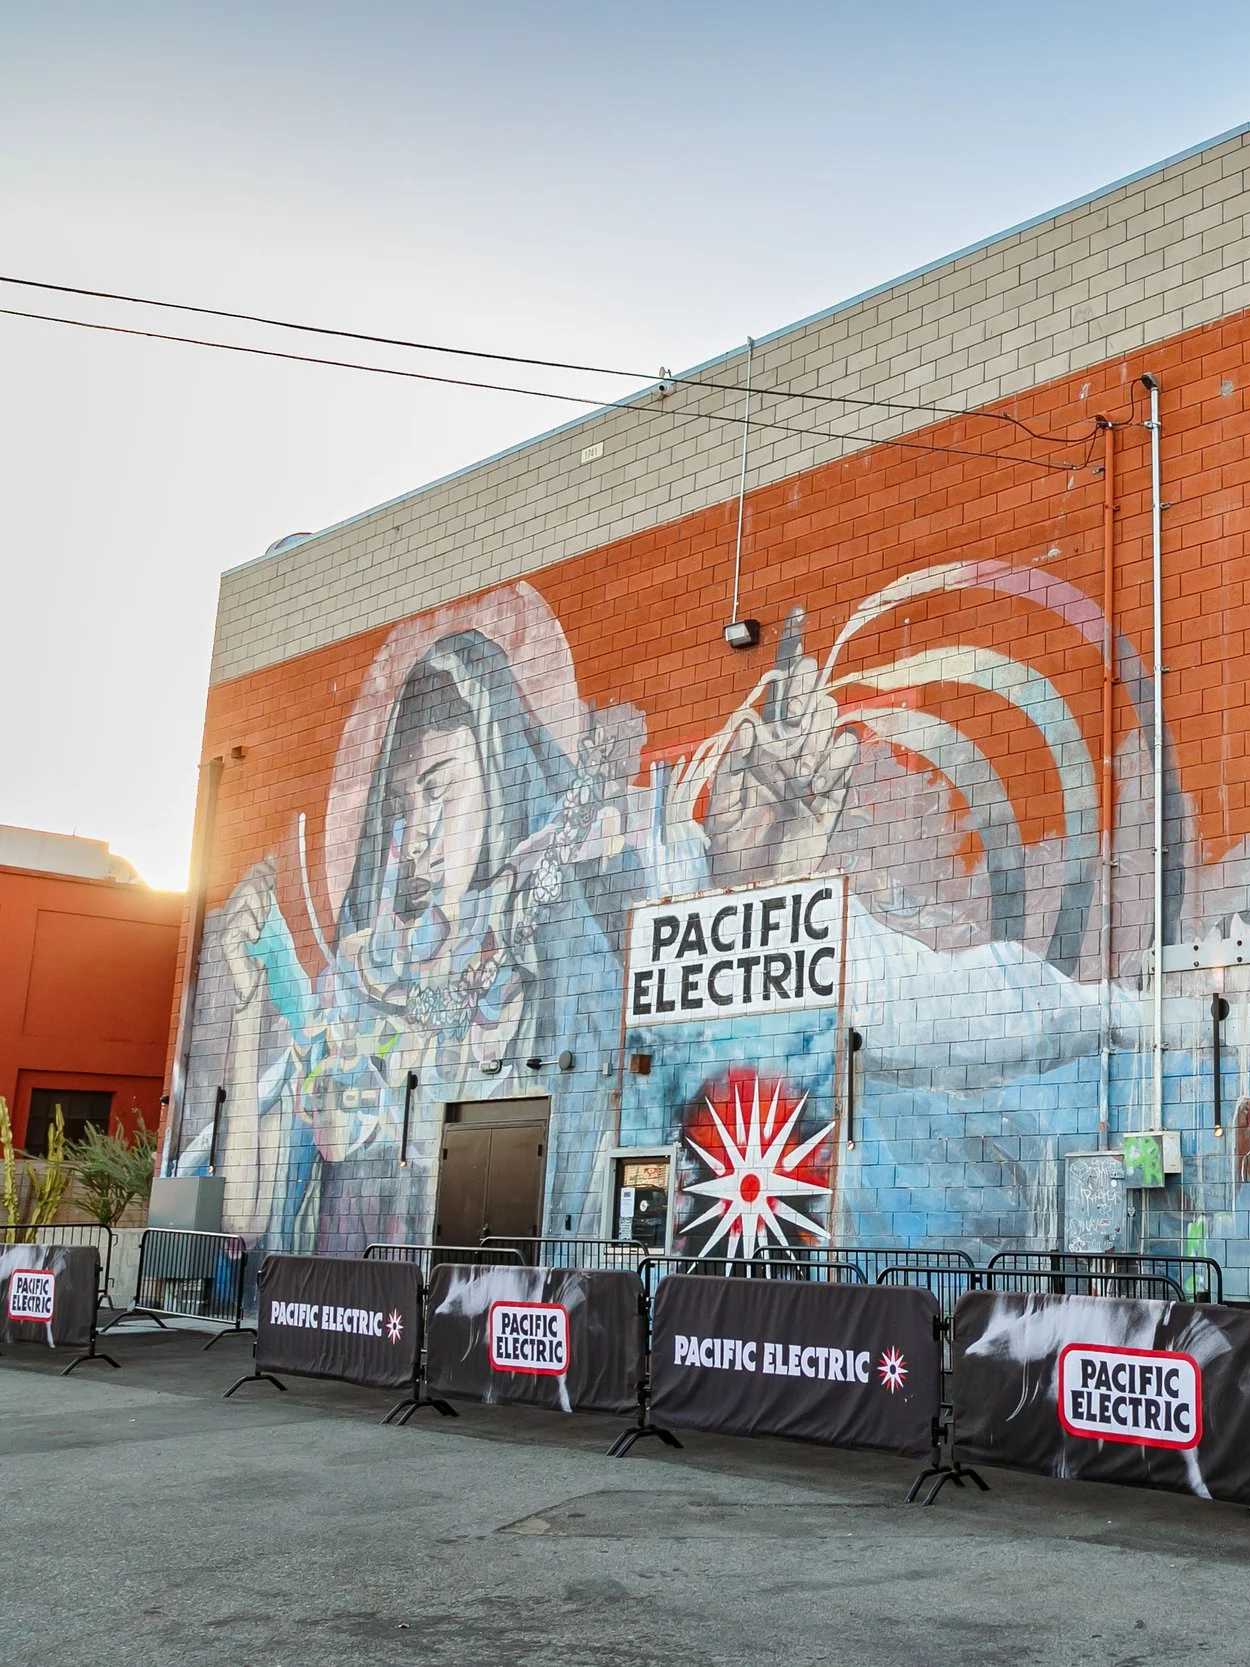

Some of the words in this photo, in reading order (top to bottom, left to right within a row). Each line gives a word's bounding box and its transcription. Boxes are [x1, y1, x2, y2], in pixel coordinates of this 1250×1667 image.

[652, 888, 832, 962] PACIFIC
[633, 946, 835, 1015] ELECTRIC
[12, 1295, 52, 1313] ELECTRIC
[16, 1277, 49, 1295] PACIFIC
[270, 1301, 319, 1329] PACIFIC
[321, 1305, 383, 1337] ELECTRIC
[501, 1312, 558, 1338] PACIFIC
[496, 1336, 563, 1363] ELECTRIC
[674, 1335, 757, 1371] PACIFIC
[762, 1342, 870, 1384] ELECTRIC
[1080, 1359, 1179, 1399] PACIFIC
[1071, 1390, 1190, 1434] ELECTRIC
